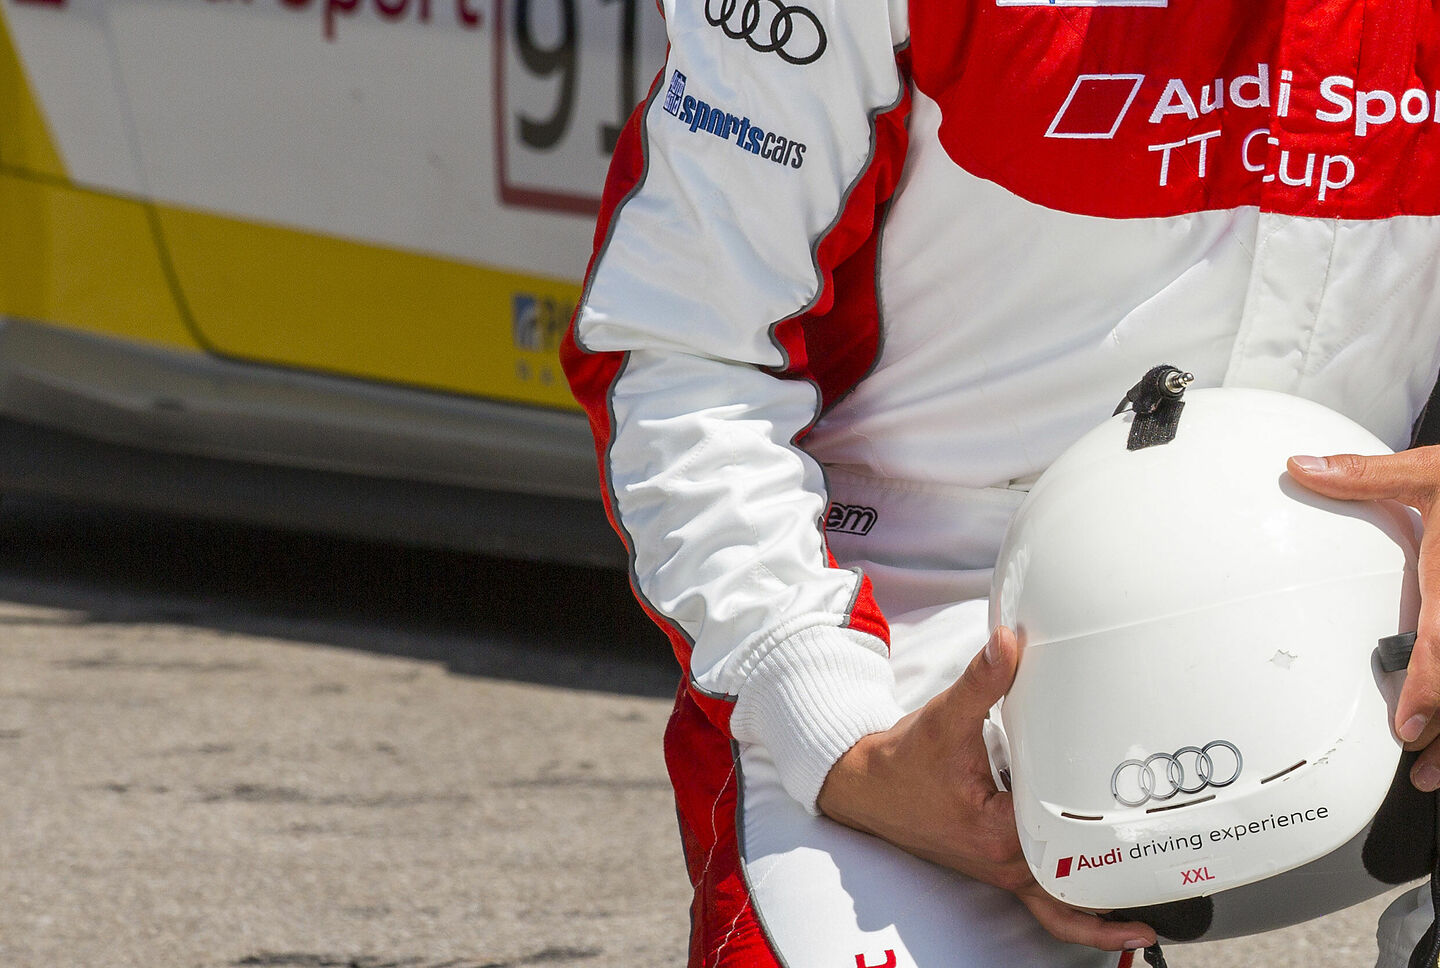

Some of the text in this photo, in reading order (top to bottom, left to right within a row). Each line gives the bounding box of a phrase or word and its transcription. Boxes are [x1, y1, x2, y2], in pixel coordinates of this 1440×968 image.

[1148, 63, 1294, 124] Audi
[1148, 128, 1355, 201] TT Cup
[1077, 805, 1329, 871] Audi driving experience
[1180, 866, 1216, 885] XXL
